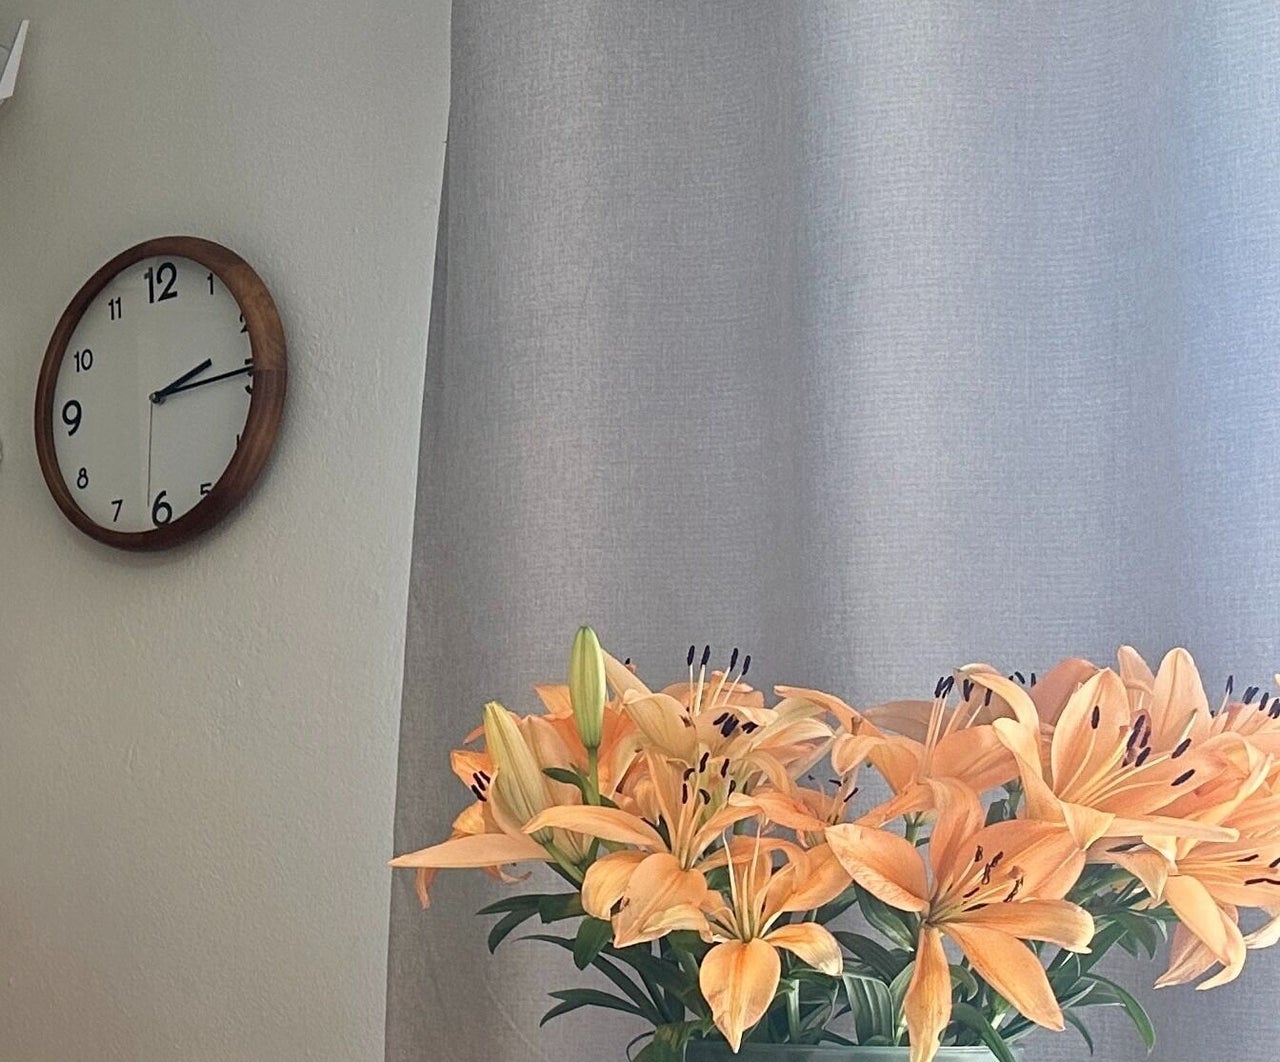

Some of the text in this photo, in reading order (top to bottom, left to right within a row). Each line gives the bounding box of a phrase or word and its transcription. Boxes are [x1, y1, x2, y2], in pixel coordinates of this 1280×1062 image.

[143, 262, 178, 303] 12
[207, 272, 215, 295] 1
[108, 297, 122, 320] 11
[74, 349, 93, 372] 10
[62, 400, 82, 436] 9
[77, 467, 89, 489] 8
[111, 499, 123, 522] 7
[152, 490, 173, 528] 6
